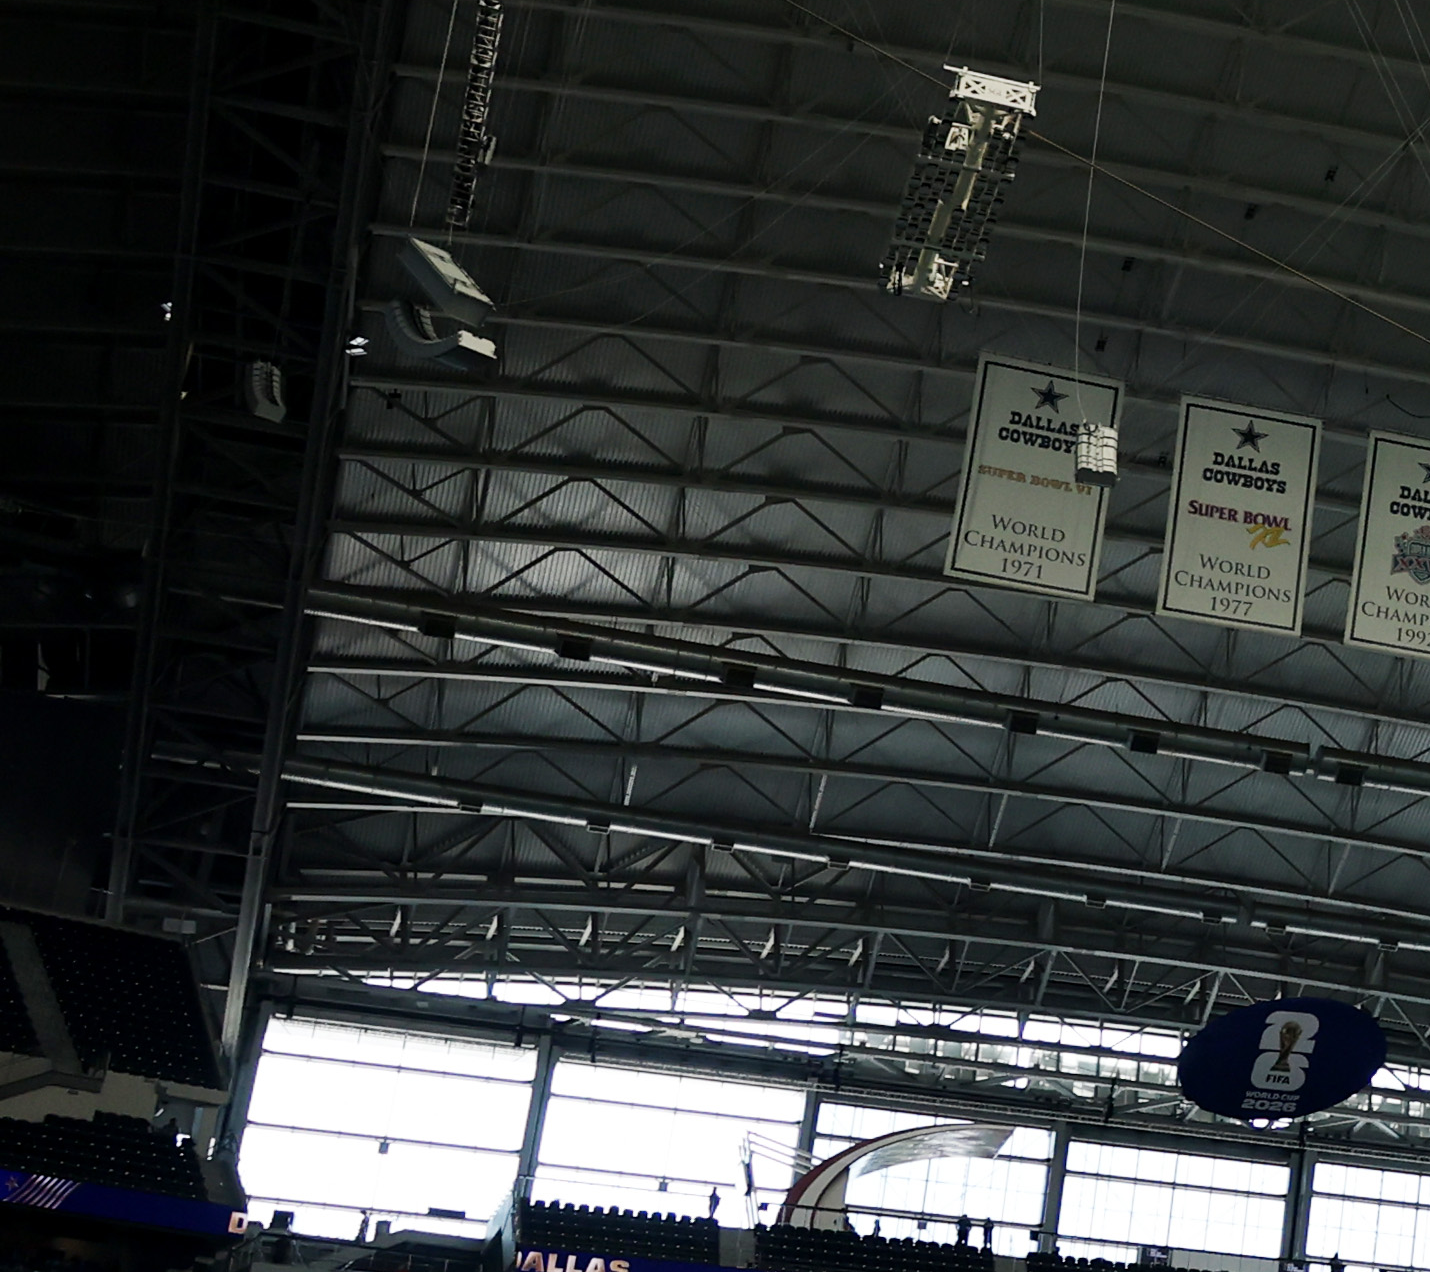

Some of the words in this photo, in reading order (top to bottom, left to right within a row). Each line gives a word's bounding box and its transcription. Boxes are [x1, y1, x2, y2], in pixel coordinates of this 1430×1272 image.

[1010, 412, 1080, 437] DALLAS
[998, 427, 1078, 455] COWBOY
[1212, 452, 1281, 476] DALLAS
[978, 464, 1026, 484] SUPER
[1029, 474, 1072, 494] BOWL
[1202, 467, 1287, 494] COWBOYS
[991, 514, 1065, 543] WORLD
[1188, 500, 1238, 522] SUPER
[1243, 511, 1292, 531] BOWL
[964, 530, 1086, 567] CHAMPIONS
[1000, 558, 1043, 579] 1971
[1199, 554, 1271, 580] WORLD
[1174, 570, 1292, 604] CHAMPIONS
[1209, 596, 1253, 617] 1977
[1265, 1074, 1290, 1084] FIFA
[1241, 1098, 1297, 1112] 2026
[1246, 1091, 1279, 1100] WORLD
